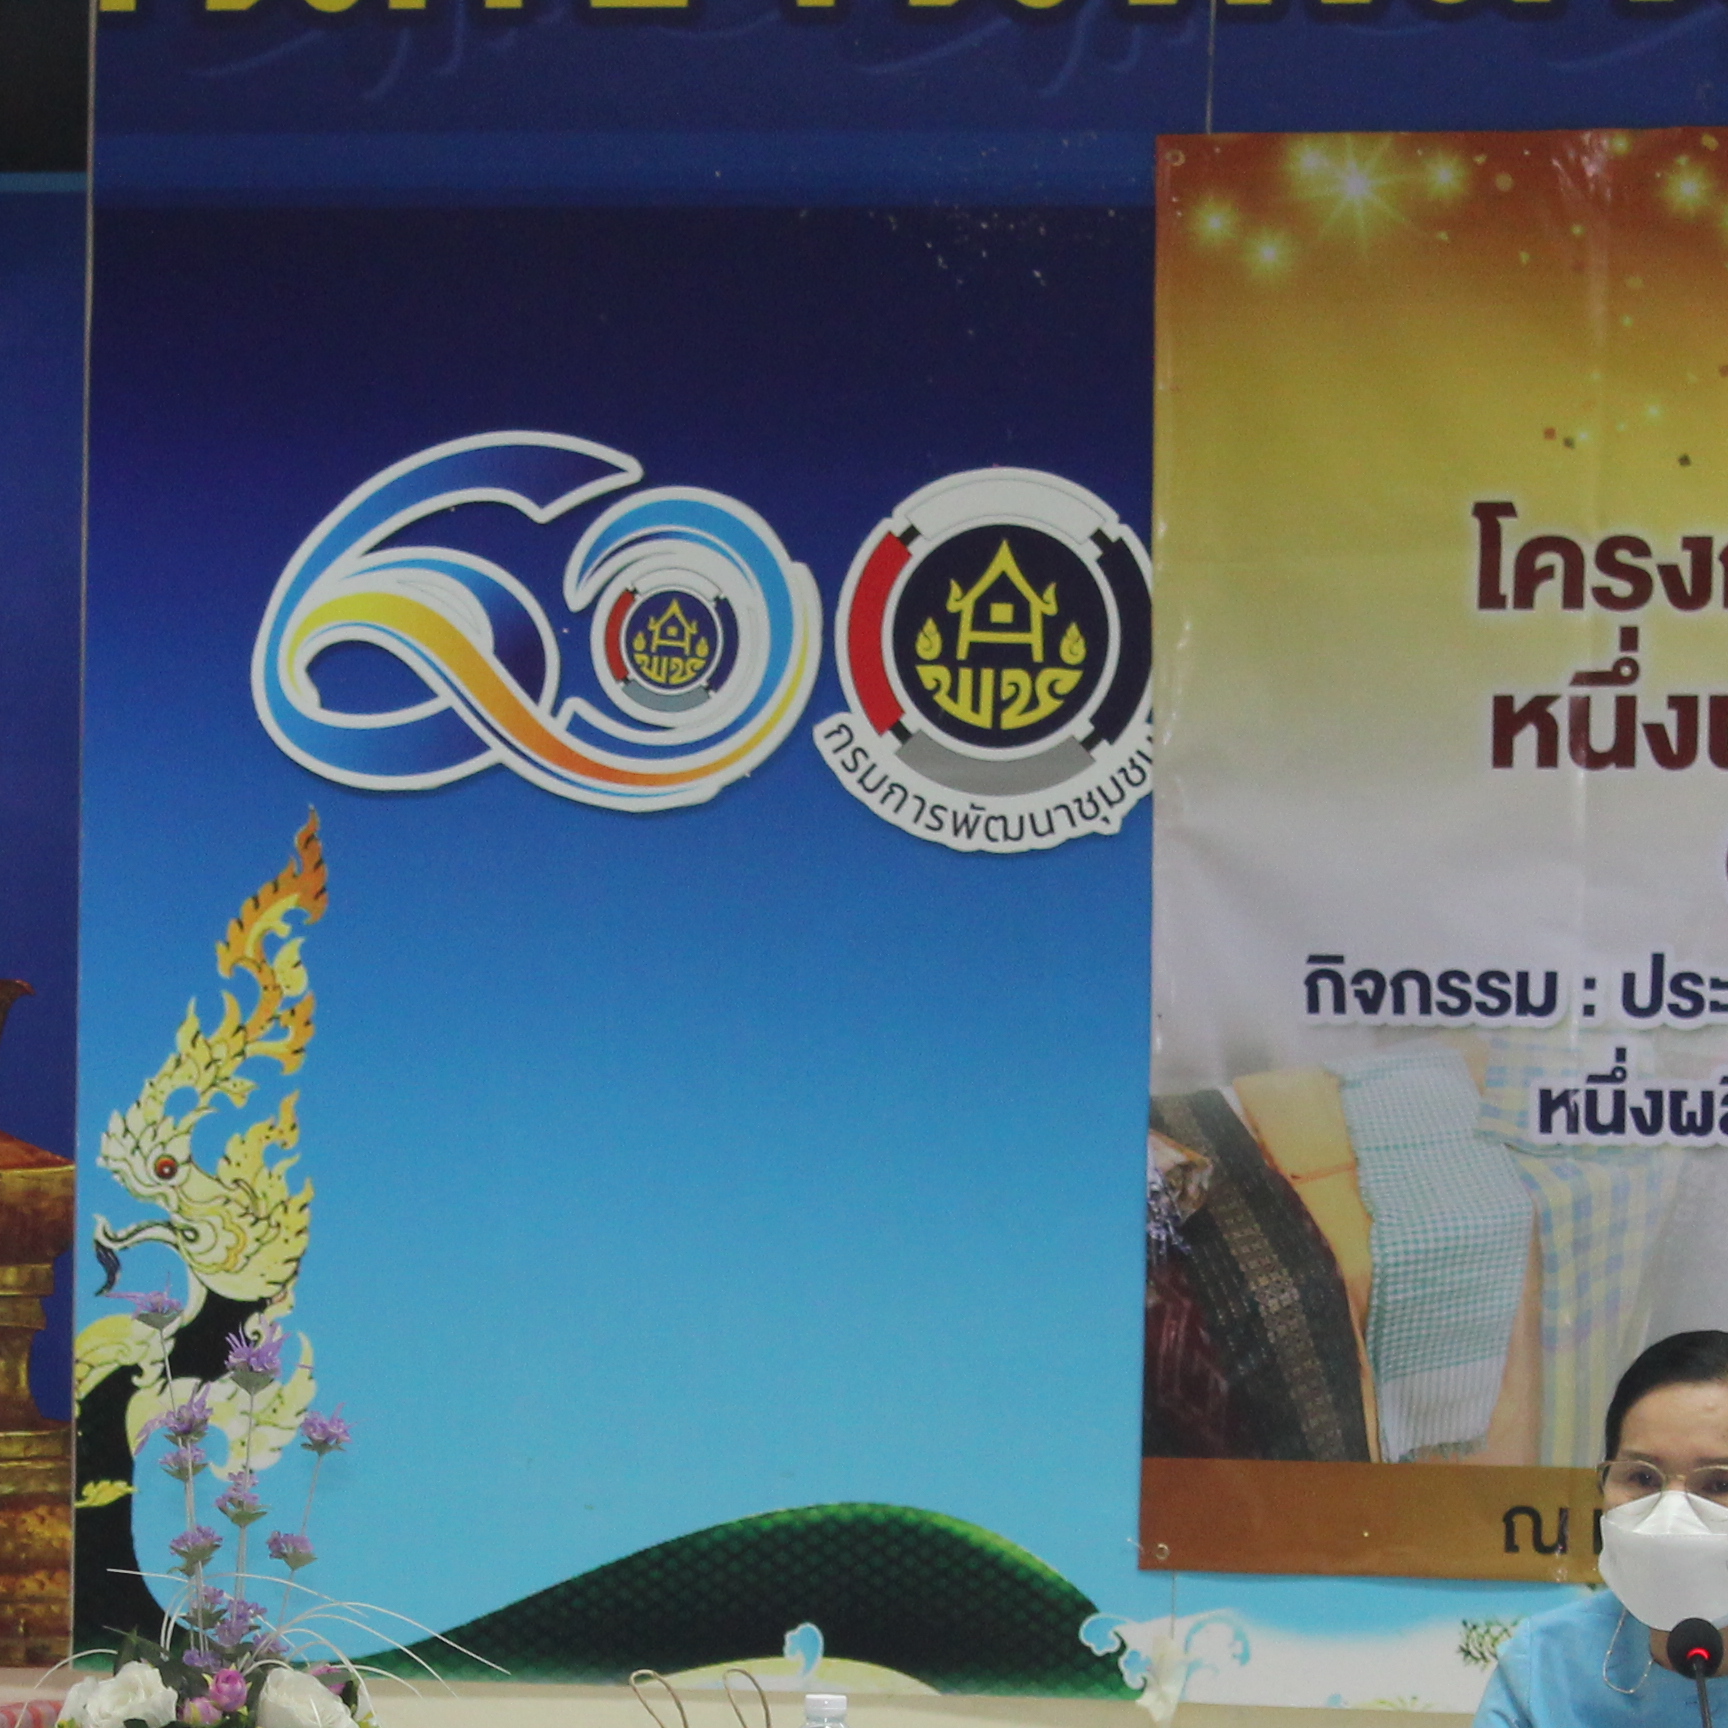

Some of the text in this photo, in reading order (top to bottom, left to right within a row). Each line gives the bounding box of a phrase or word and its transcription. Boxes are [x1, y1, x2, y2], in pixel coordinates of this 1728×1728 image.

[823, 723, 1152, 843] กรมการพัฒนาชุมช
[1304, 953, 1559, 1018] กิจกรรม
